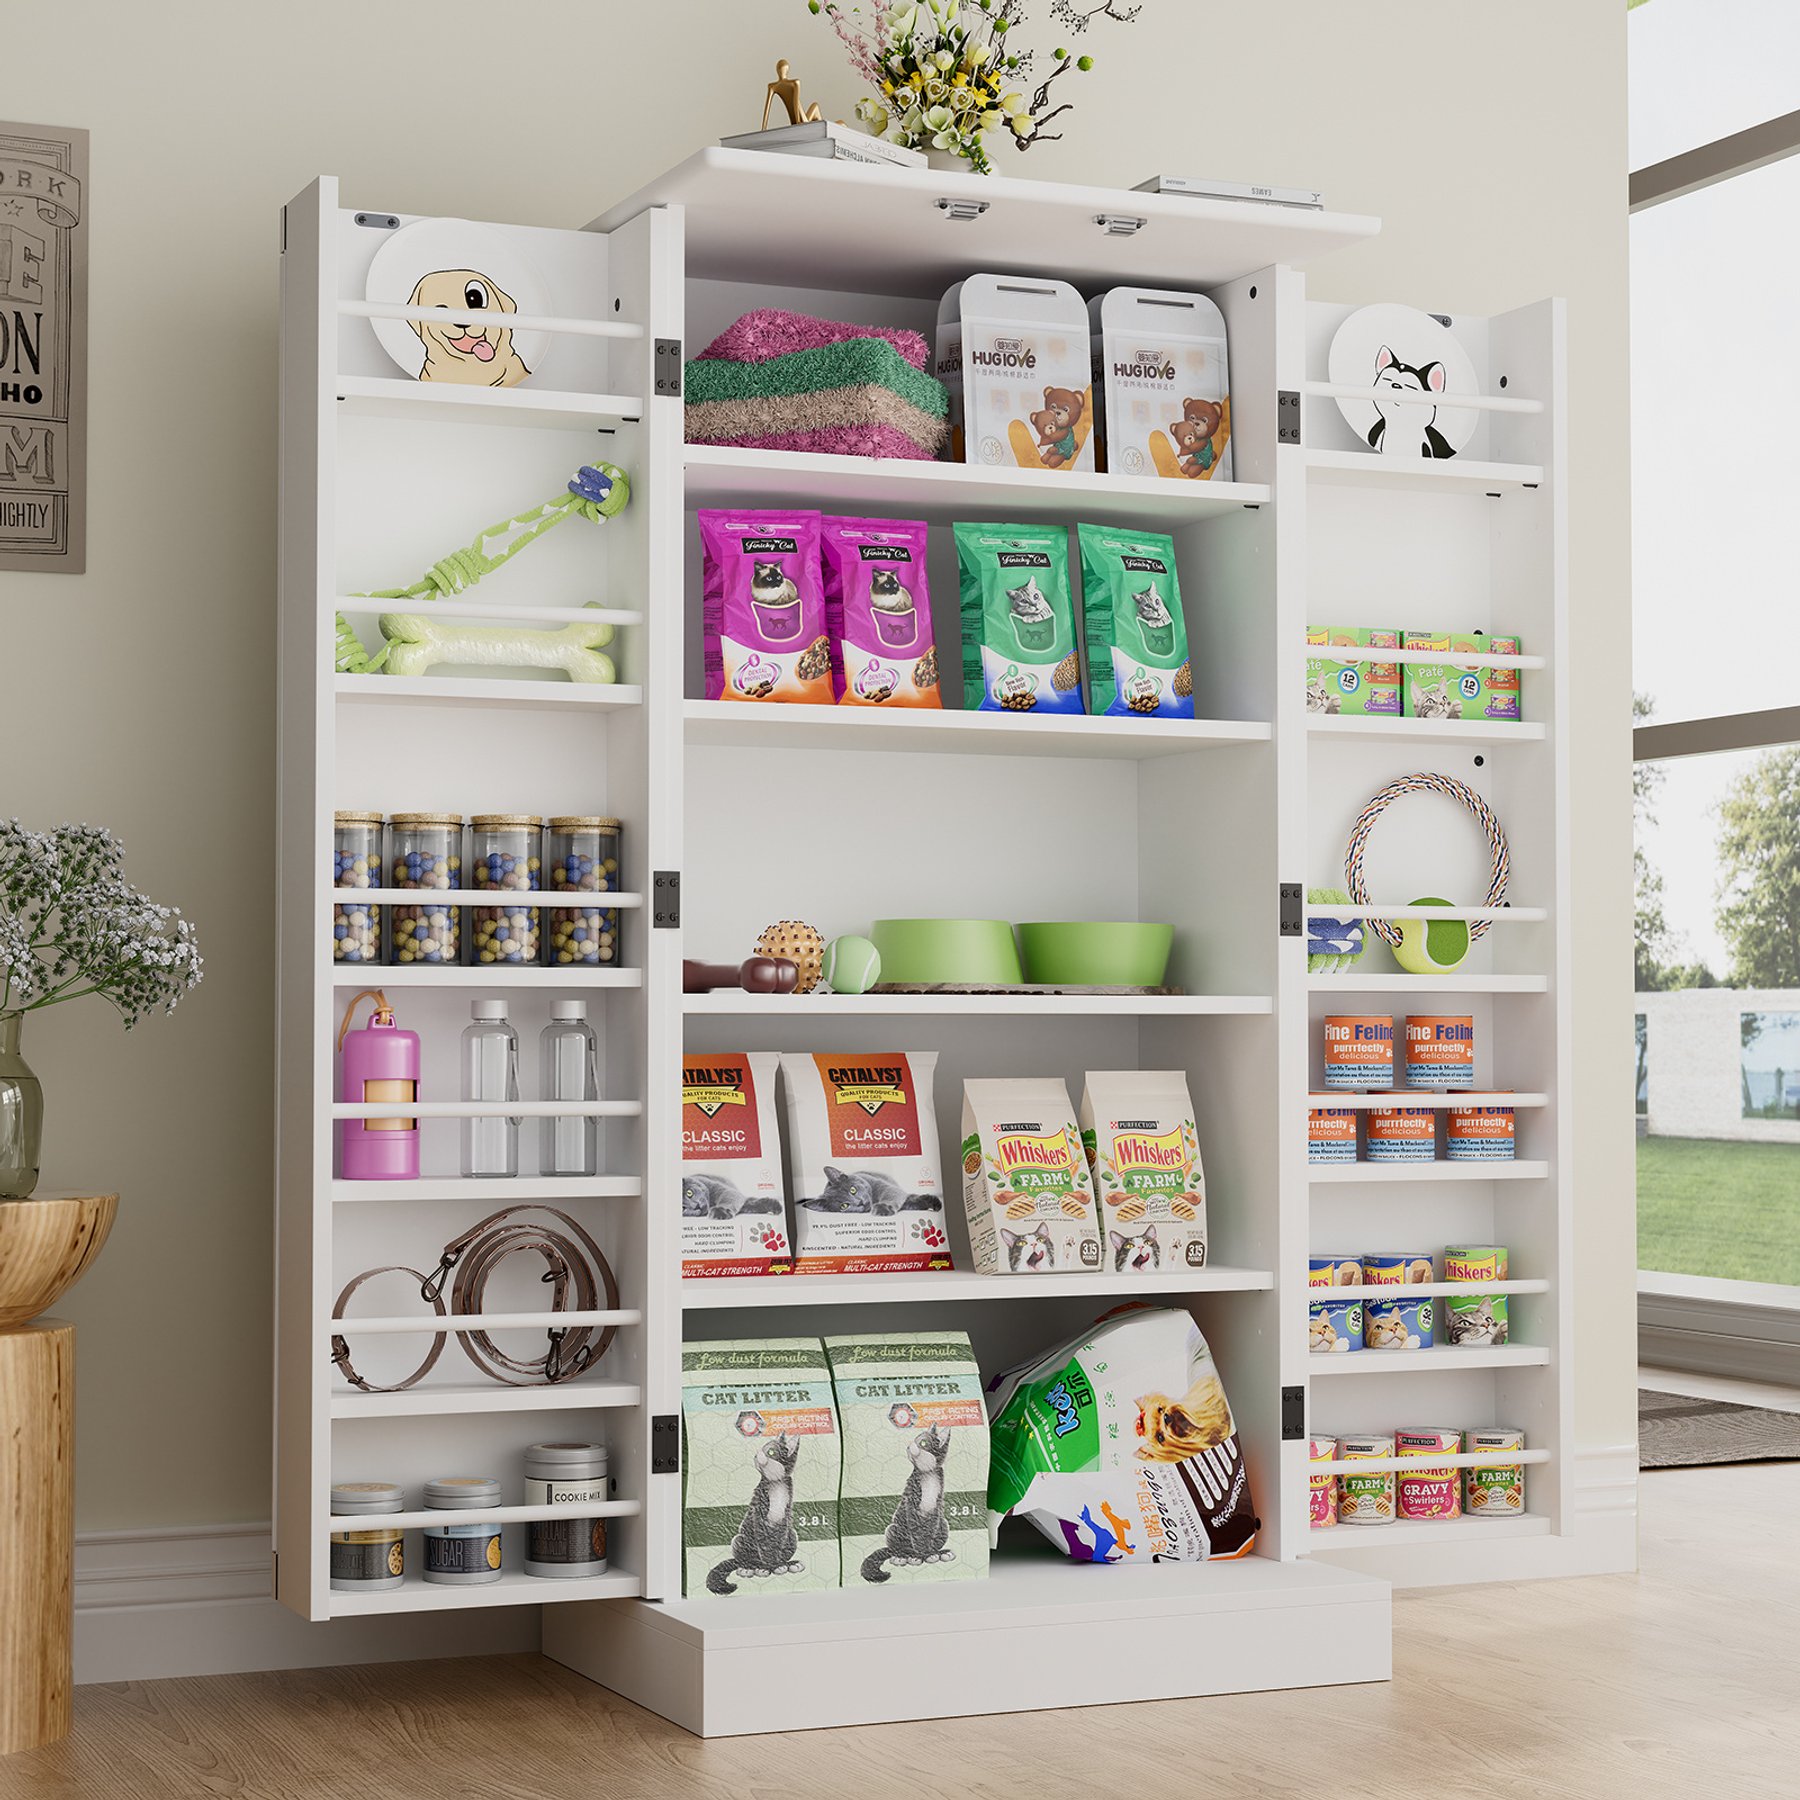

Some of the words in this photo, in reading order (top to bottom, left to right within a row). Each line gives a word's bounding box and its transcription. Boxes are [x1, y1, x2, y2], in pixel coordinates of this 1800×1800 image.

[0, 502, 49, 528] IGHTLY
[779, 541, 794, 550] Cat
[895, 549, 908, 559] Cat
[1033, 556, 1047, 565] Cat
[1152, 562, 1163, 571] Cat
[1343, 673, 1355, 684] 12
[1007, 682, 1028, 693] Flavor
[1464, 679, 1476, 691] 12
[1334, 1044, 1384, 1054] purrrfectly
[1415, 1044, 1465, 1053] purrrfectly
[683, 1068, 743, 1084] ATALYST
[828, 1068, 903, 1084] CATALYST
[707, 1089, 739, 1098] PRODUCTS
[840, 1090, 867, 1098] QUALITY
[868, 1089, 899, 1097] PRODUCTS
[1001, 1123, 1041, 1131] PURFECTION
[1119, 1120, 1158, 1129] PURFECTION
[1376, 1119, 1426, 1129] purrrfectly
[1456, 1118, 1506, 1127] purrrfectly
[682, 1130, 746, 1144] CLASSIC
[844, 1128, 906, 1142] CLASSIC
[695, 1143, 710, 1151] litter
[724, 1143, 747, 1152] enjoy
[888, 1142, 908, 1151] enjoy
[1117, 1137, 1182, 1166] Whiskers
[1001, 1139, 1068, 1168] Whiskers
[1019, 1172, 1064, 1187] FARM
[1132, 1173, 1176, 1188] FARM
[682, 1268, 721, 1277] MULTI-CAT
[721, 1266, 763, 1276] STRENGTH
[844, 1263, 885, 1273] MULTI-CAT
[885, 1261, 924, 1272] STRENGTH
[1445, 1264, 1492, 1281] hiskers
[1364, 1269, 1401, 1286] hiskers
[849, 1346, 877, 1363] Low
[880, 1346, 906, 1357] dust
[907, 1345, 958, 1361] formula
[696, 1353, 725, 1370] Low
[728, 1353, 755, 1364] dust
[757, 1352, 808, 1368] formula
[855, 1384, 890, 1398] CAT
[894, 1382, 962, 1397] LITTER
[702, 1392, 737, 1406] CAT
[742, 1389, 812, 1404] LITTER
[1482, 1471, 1511, 1482] FARM
[1351, 1479, 1381, 1490] FARM
[1403, 1483, 1449, 1496] GRAVY
[554, 1492, 588, 1502] COOKIE
[589, 1491, 601, 1500] MIX
[1408, 1496, 1445, 1505] Swirlers
[950, 1506, 969, 1517] 3.8
[799, 1516, 818, 1527] 3.8
[429, 1538, 464, 1567] SUGAR
